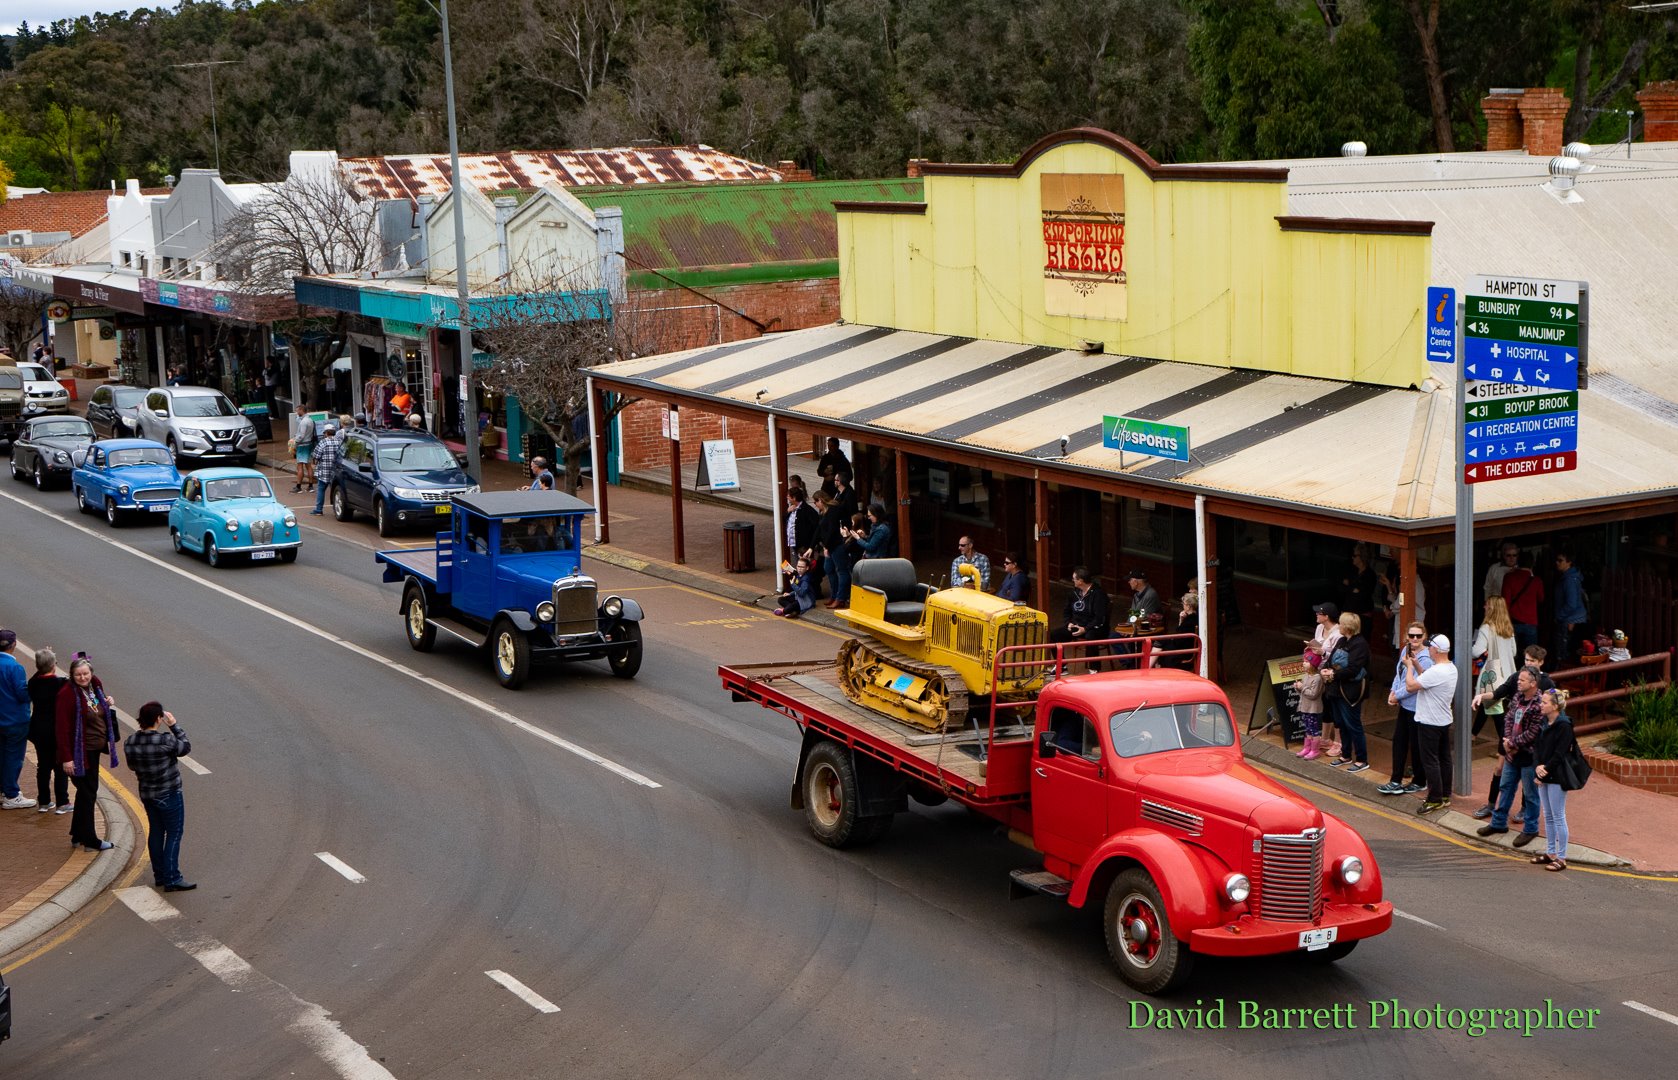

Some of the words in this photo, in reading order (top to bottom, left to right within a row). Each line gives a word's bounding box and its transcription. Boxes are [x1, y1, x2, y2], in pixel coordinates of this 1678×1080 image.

[1042, 221, 1125, 245] EMPORIUM
[1045, 241, 1124, 273] BISTRO
[1486, 280, 1537, 297] HAMPTON
[1542, 284, 1556, 298] ST
[1478, 300, 1521, 316] BUNBURY
[1550, 307, 1562, 319] 94
[1430, 326, 1451, 337] Visitor
[1478, 321, 1489, 334] 36
[1519, 325, 1566, 341] MANJIMUP
[1430, 336, 1452, 347] Centre
[1506, 346, 1550, 362] HOSPITAL
[1479, 382, 1519, 398] STEERE
[1479, 405, 1489, 417] 31
[1504, 399, 1535, 414] BOYUP
[1538, 396, 1569, 410] BROOK
[1486, 418, 1541, 437] RECREATION
[1542, 415, 1576, 430] CENTRE
[1485, 463, 1502, 477] THE
[1505, 460, 1538, 475] CIDERY
[1303, 934, 1311, 944] 46
